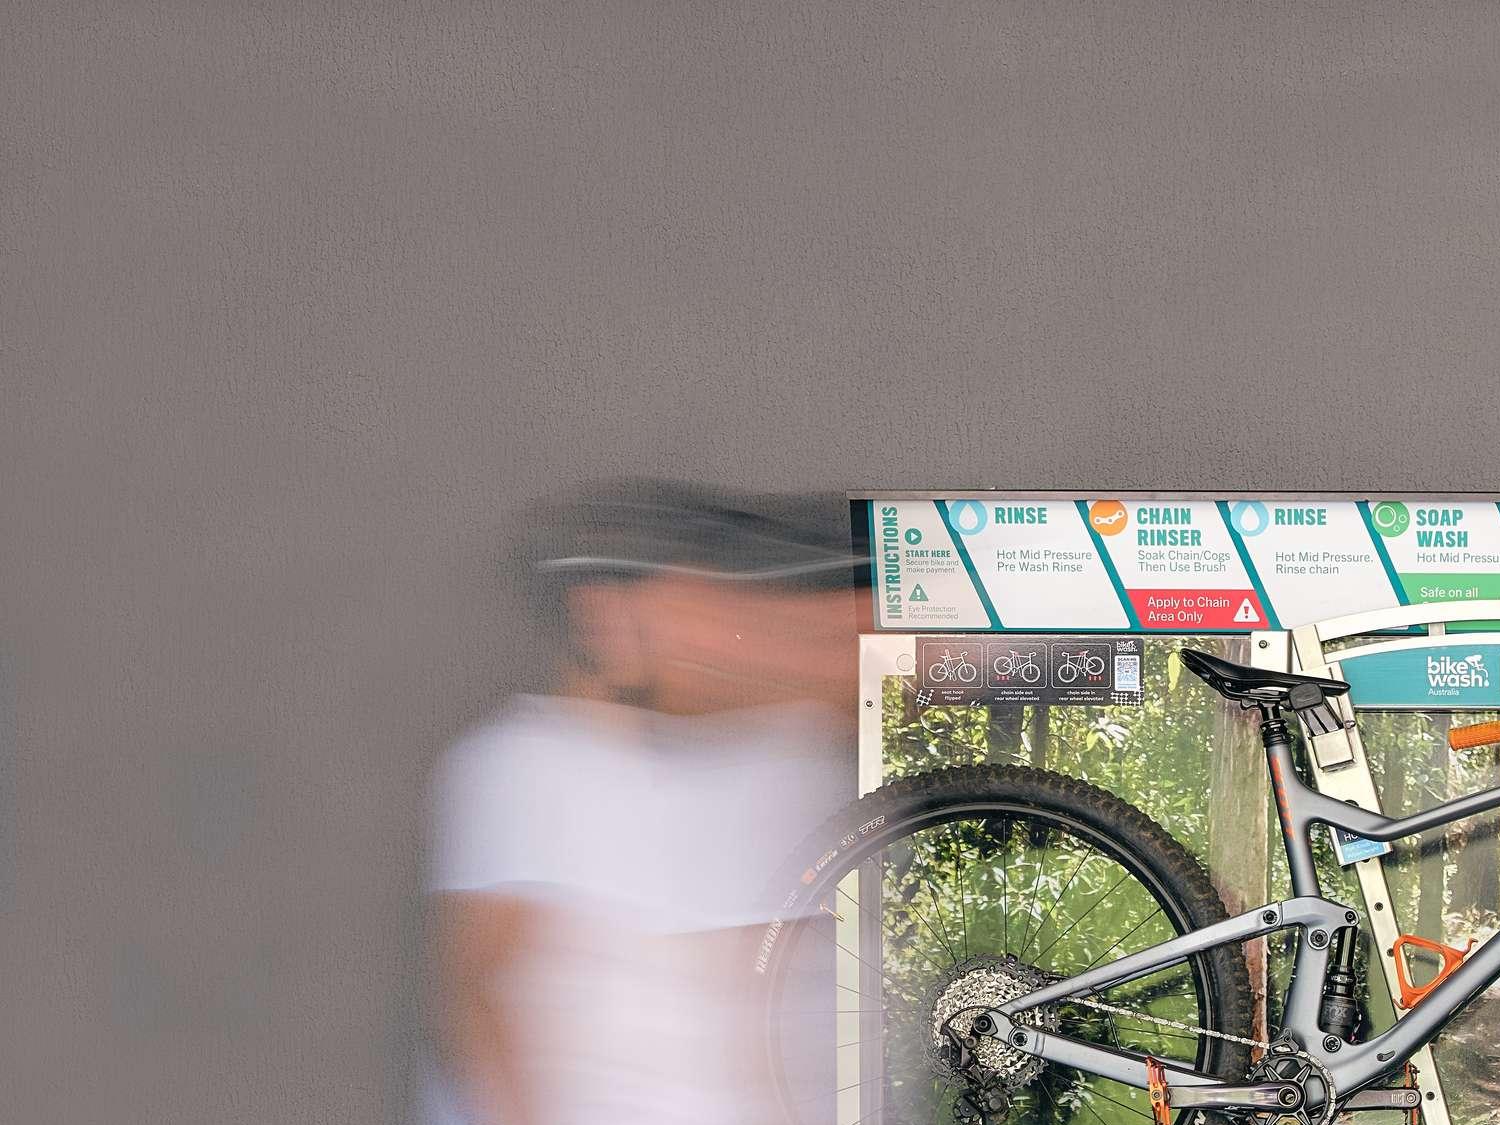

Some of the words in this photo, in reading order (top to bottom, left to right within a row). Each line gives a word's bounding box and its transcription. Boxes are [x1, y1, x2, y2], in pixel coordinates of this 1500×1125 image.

[994, 507, 1048, 524] RINSE
[1136, 507, 1192, 525] CHAIN
[1274, 508, 1327, 526] RINSE
[1416, 509, 1464, 526] SOAP
[1137, 529, 1202, 546] RINSER
[1416, 531, 1468, 548] WASH
[905, 550, 929, 558] START
[931, 550, 951, 558] HERE
[996, 550, 1018, 560] Hot
[1020, 550, 1041, 560] Mid
[1044, 550, 1092, 560] Pressure
[1137, 550, 1165, 561] Soak
[1168, 550, 1231, 563] Chain/Cogs
[1275, 552, 1296, 563] Hot
[1298, 552, 1320, 563] Mid
[1416, 552, 1437, 563] Hot
[1439, 552, 1460, 563] Mid
[881, 506, 903, 619] INSTRUCTIONS
[997, 562, 1017, 572] Pre
[1019, 562, 1049, 572] Wash
[1052, 562, 1083, 572] Rinse
[1138, 562, 1166, 572] Then
[1170, 562, 1191, 572] Use
[1194, 562, 1226, 572] Brush
[1275, 564, 1307, 575] Rinse
[1309, 564, 1340, 575] chain
[1420, 586, 1445, 598] Safe
[1448, 589, 1462, 598] on
[1465, 587, 1478, 598] all
[908, 605, 921, 613] Eye
[921, 605, 957, 613] Protection
[1147, 596, 1180, 610] Apply
[1182, 598, 1195, 608] to
[1197, 596, 1230, 608] Chain
[1148, 611, 1174, 622] Area
[1177, 611, 1204, 624] Only
[1427, 656, 1469, 674] bike
[1428, 670, 1484, 688] wash
[1428, 688, 1460, 696] Australia
